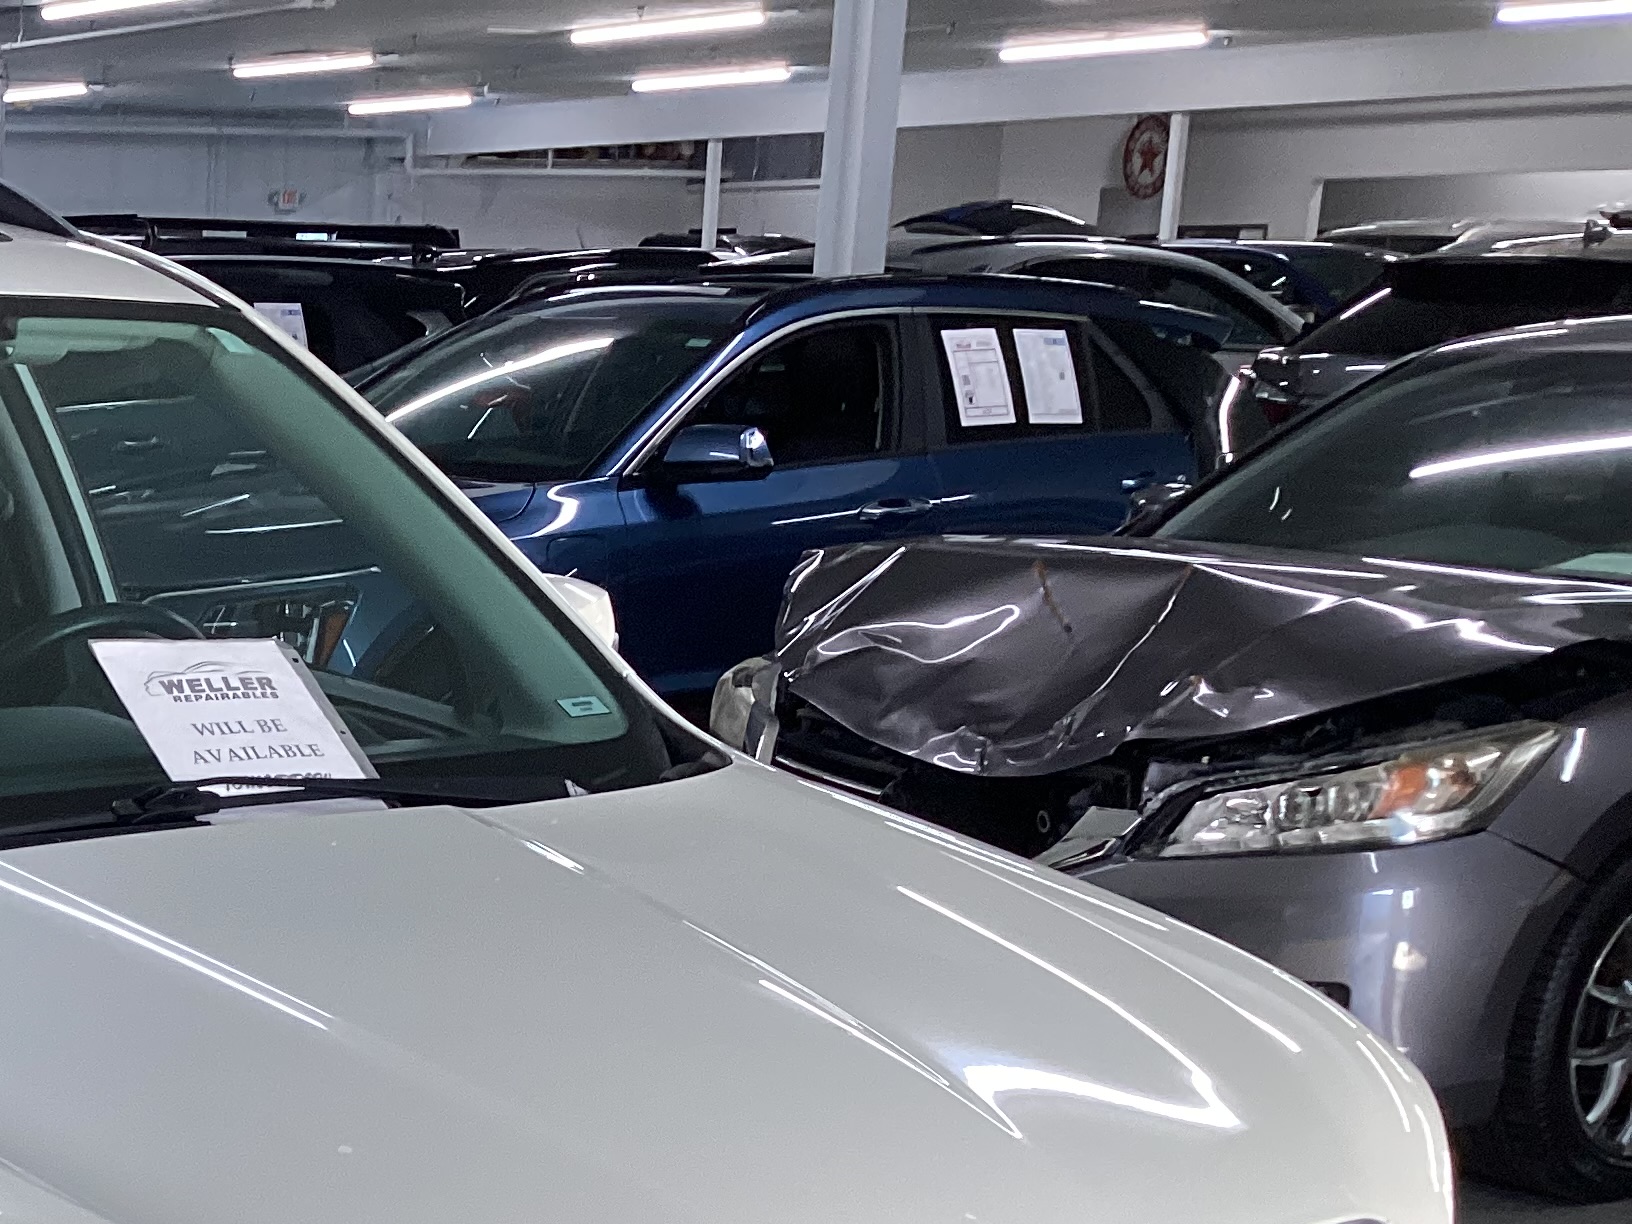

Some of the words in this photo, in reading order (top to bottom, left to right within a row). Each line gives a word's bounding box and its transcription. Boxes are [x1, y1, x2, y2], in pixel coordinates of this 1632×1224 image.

[158, 676, 277, 695] WELLER
[172, 691, 279, 703] REPAIRABLES
[191, 720, 254, 737] WILL
[254, 718, 288, 734] BE
[193, 743, 325, 765] AVAILABLE
